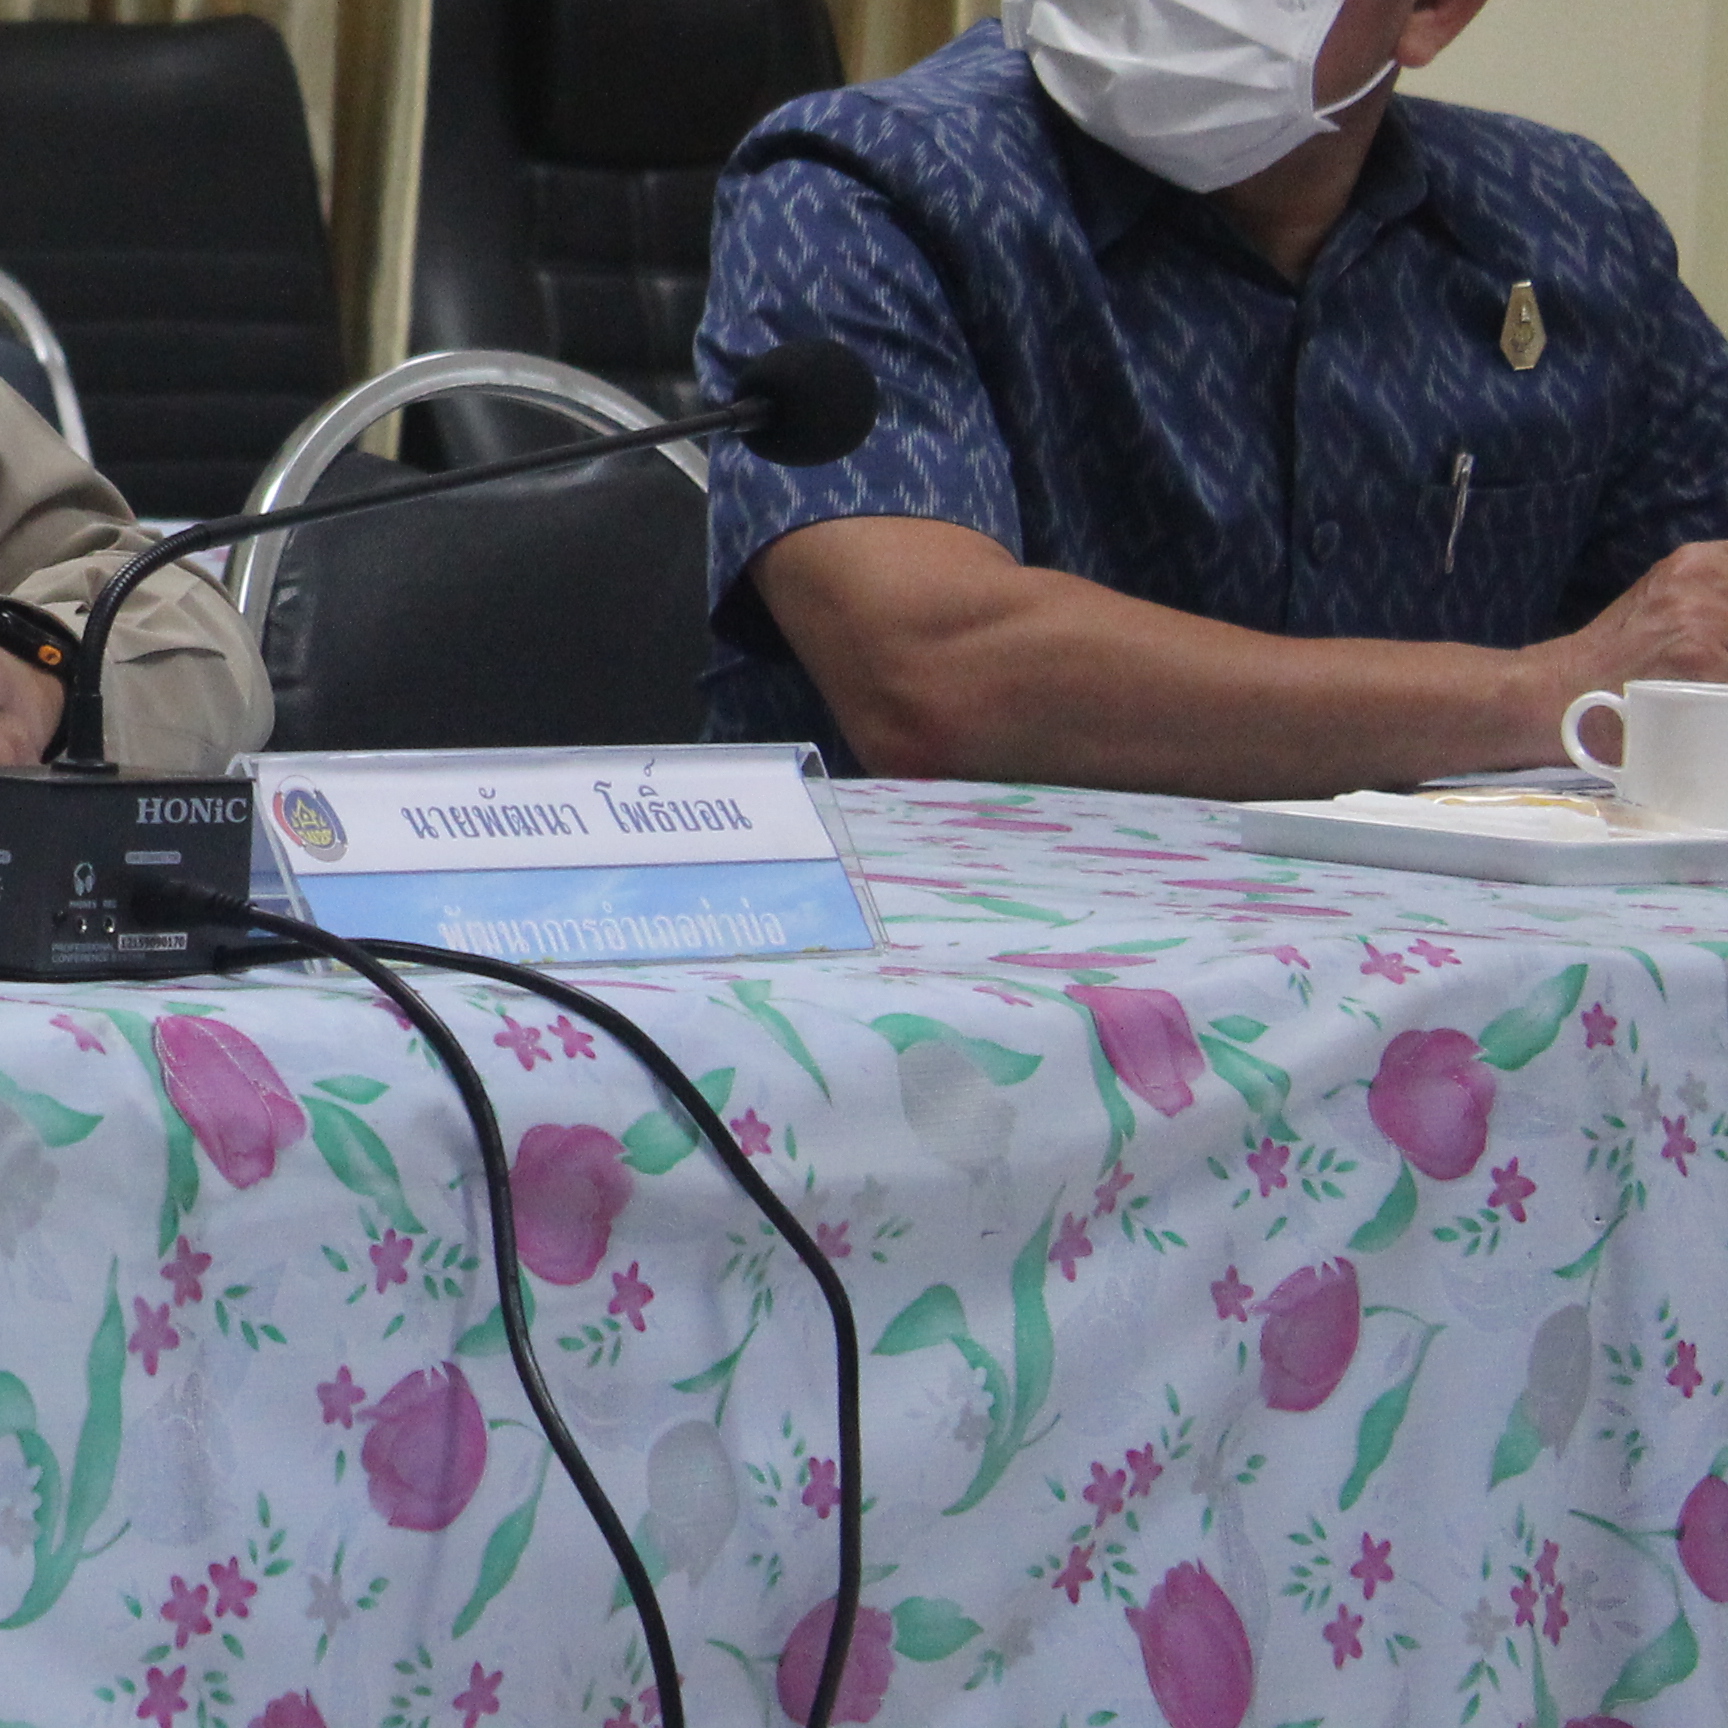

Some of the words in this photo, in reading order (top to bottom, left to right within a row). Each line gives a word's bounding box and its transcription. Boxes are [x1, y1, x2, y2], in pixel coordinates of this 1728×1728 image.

[400, 786, 591, 840] นายพัฒนา
[593, 758, 753, 834] โพธิ์บอน
[437, 896, 787, 956] พัฒนาการอำเภอท่าบ่อ
